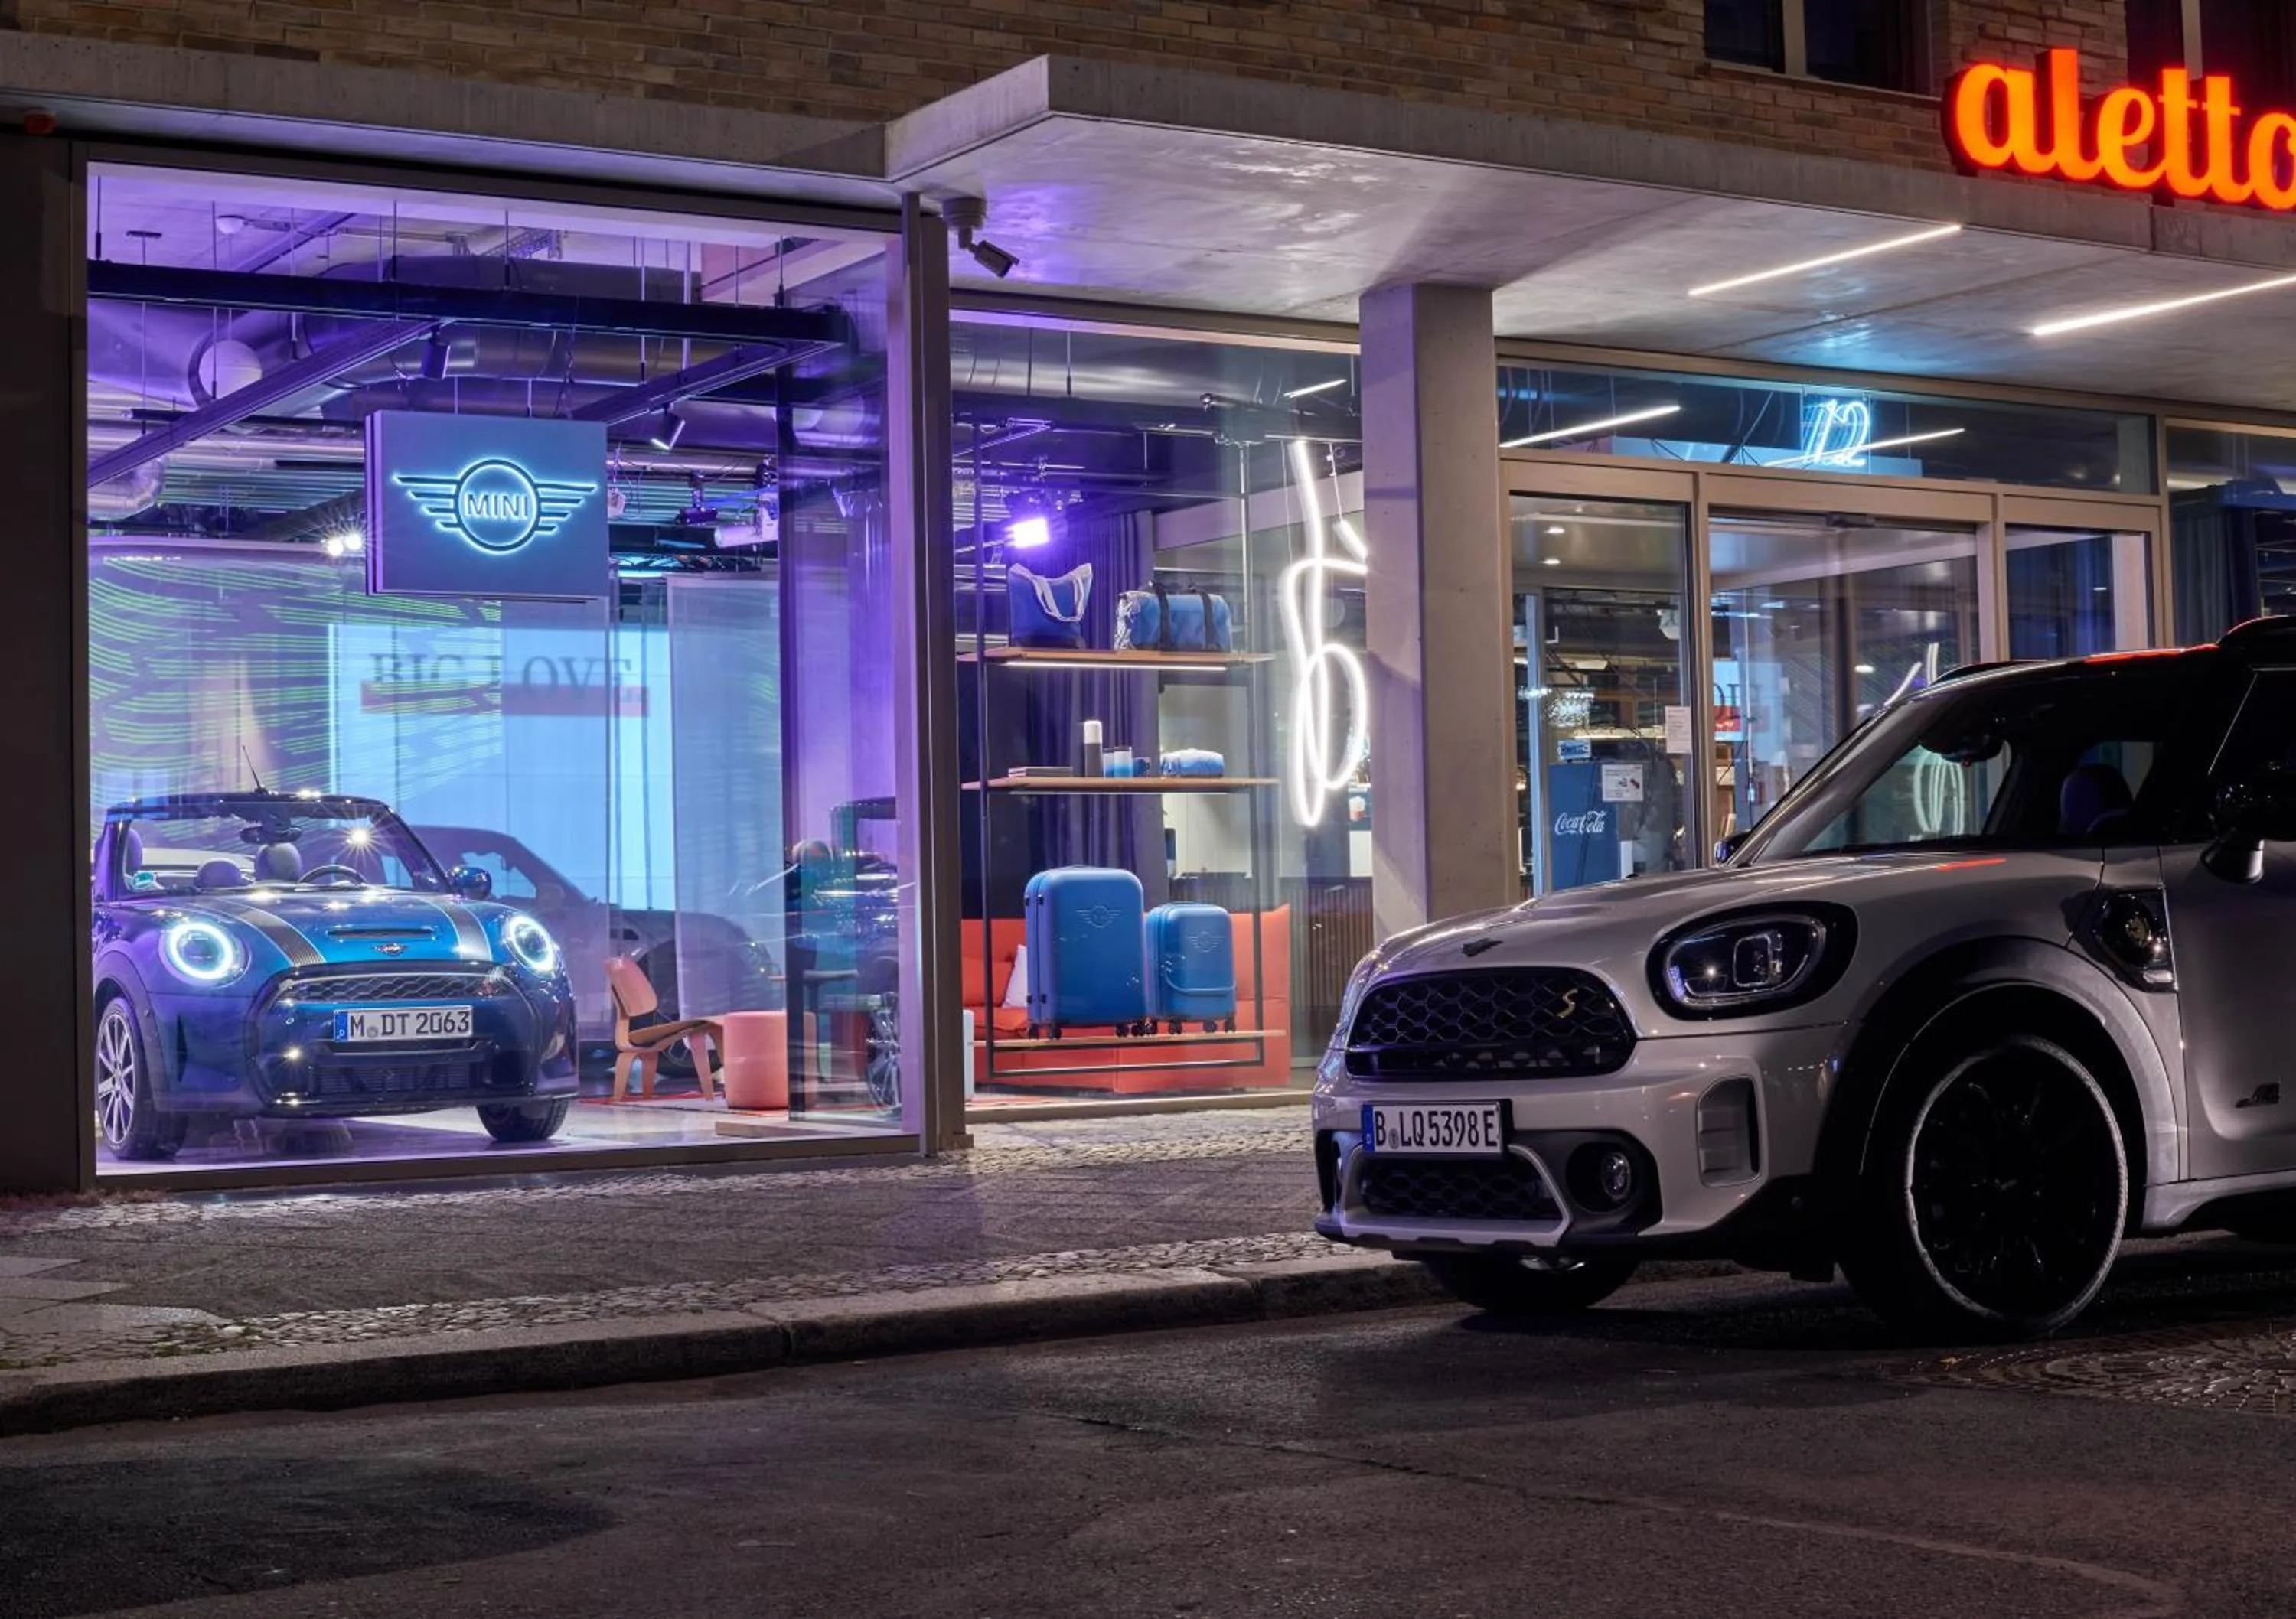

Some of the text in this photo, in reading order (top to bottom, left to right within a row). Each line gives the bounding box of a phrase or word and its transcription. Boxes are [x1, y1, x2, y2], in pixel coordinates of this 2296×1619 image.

[1955, 47, 2296, 210] aletto
[464, 493, 529, 520] MINI
[350, 1011, 470, 1037] M DT 2063
[1375, 1111, 1386, 1146] B
